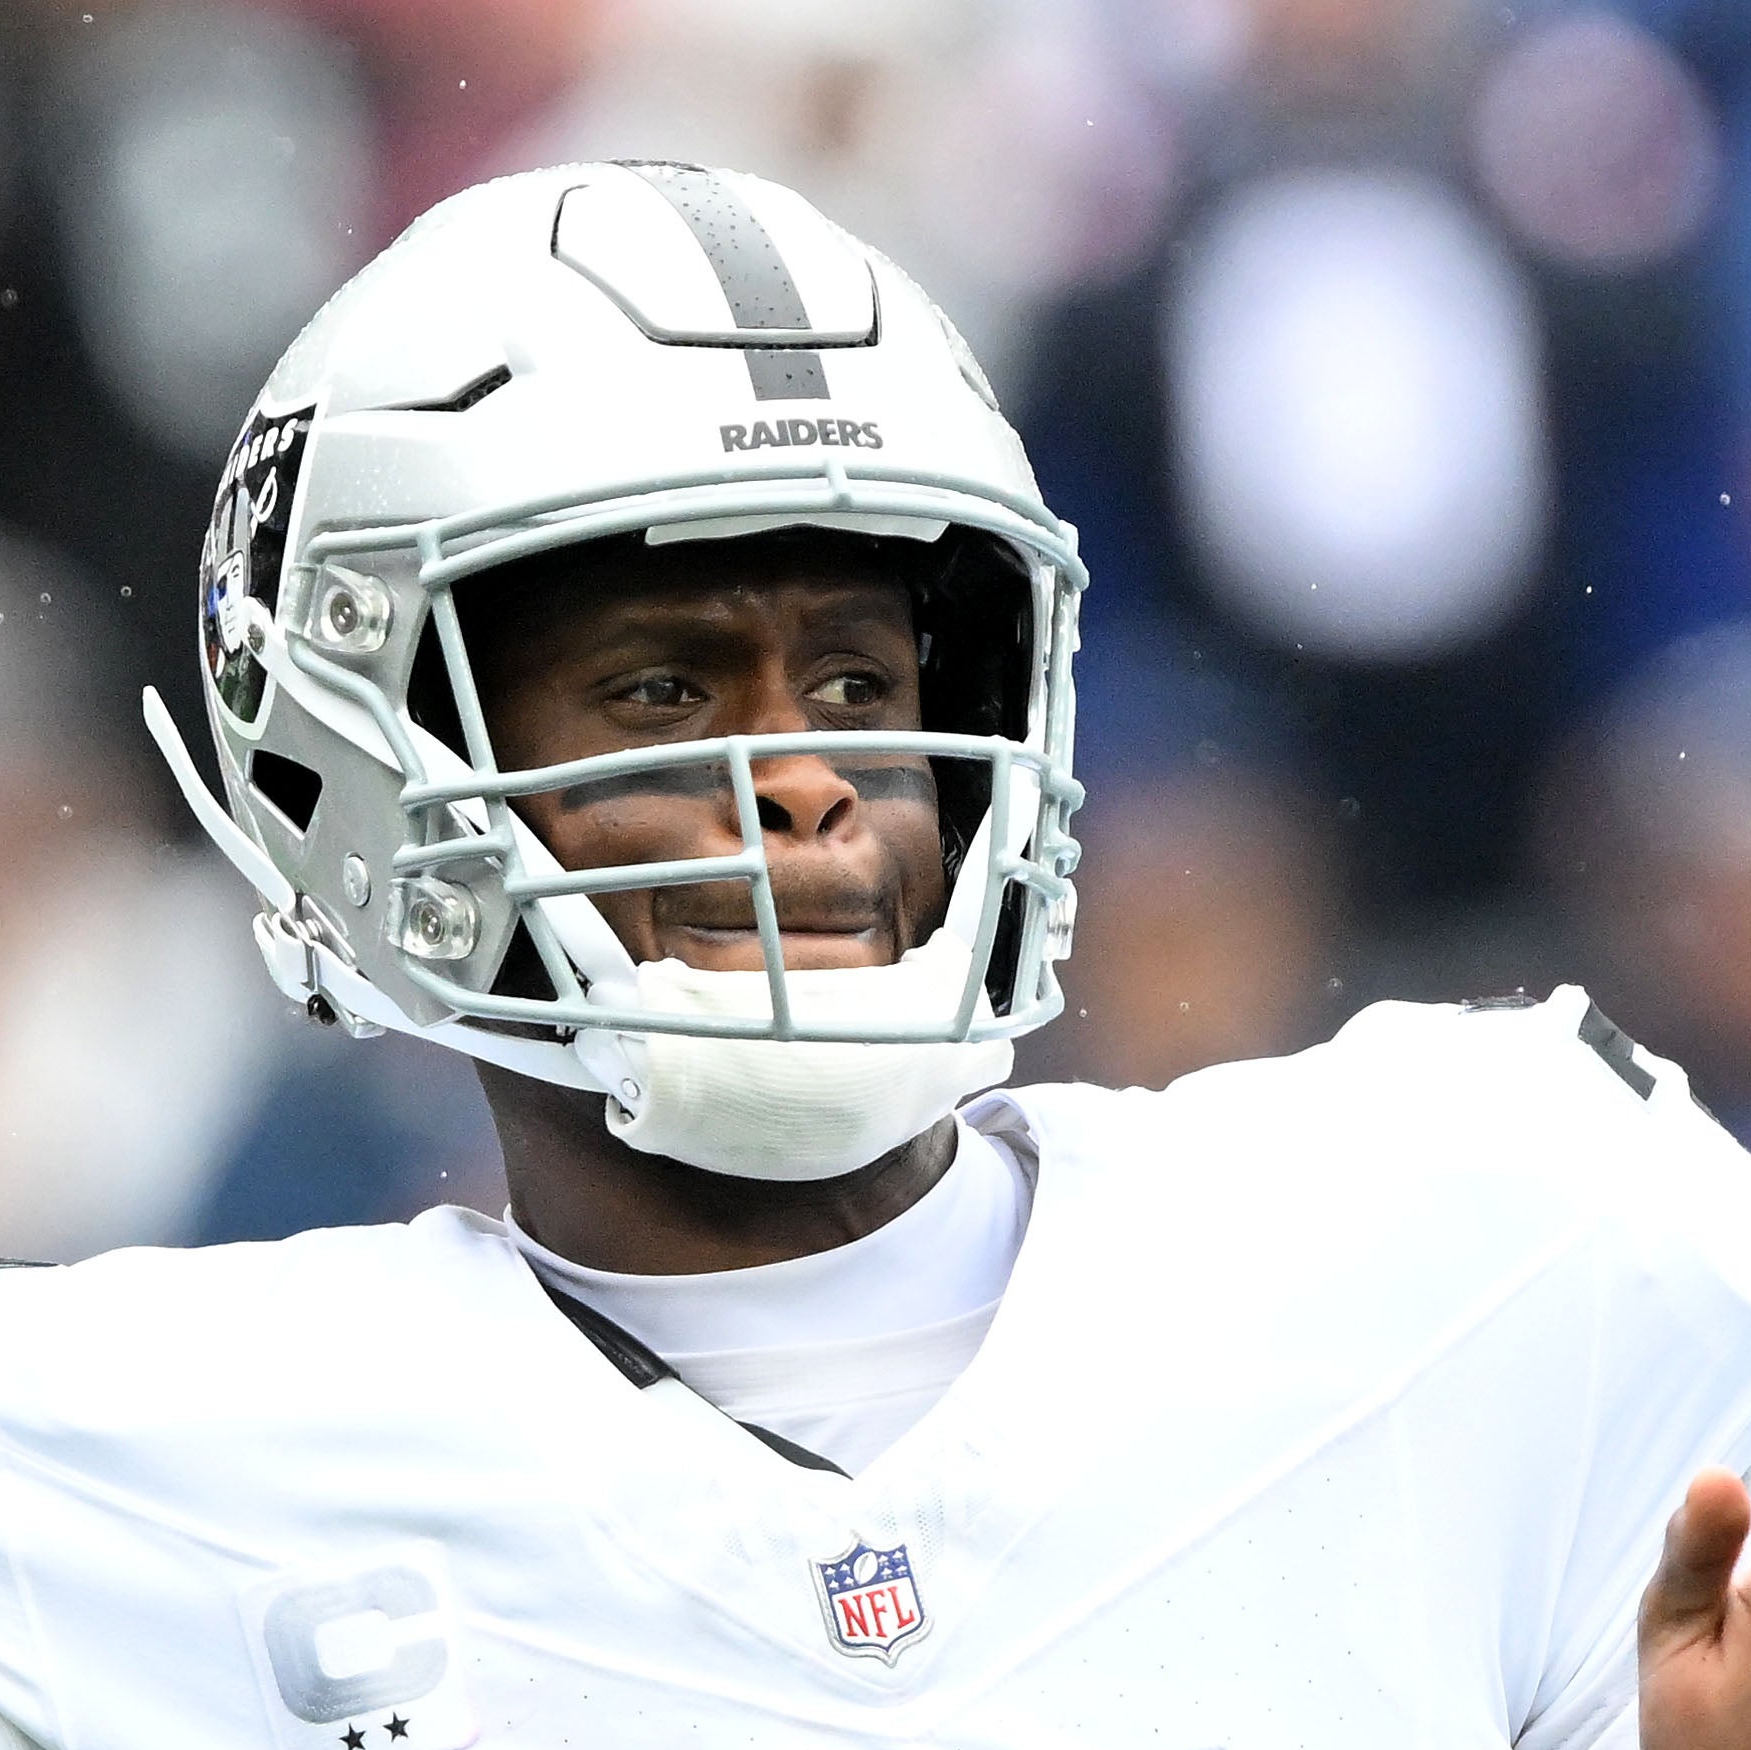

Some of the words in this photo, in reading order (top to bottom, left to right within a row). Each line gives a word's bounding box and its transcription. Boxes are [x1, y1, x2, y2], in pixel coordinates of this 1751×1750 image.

[216, 418, 298, 502] IDERS
[719, 418, 884, 452] RAIDERS
[263, 1564, 448, 1727] C
[837, 1586, 915, 1638] NFL
